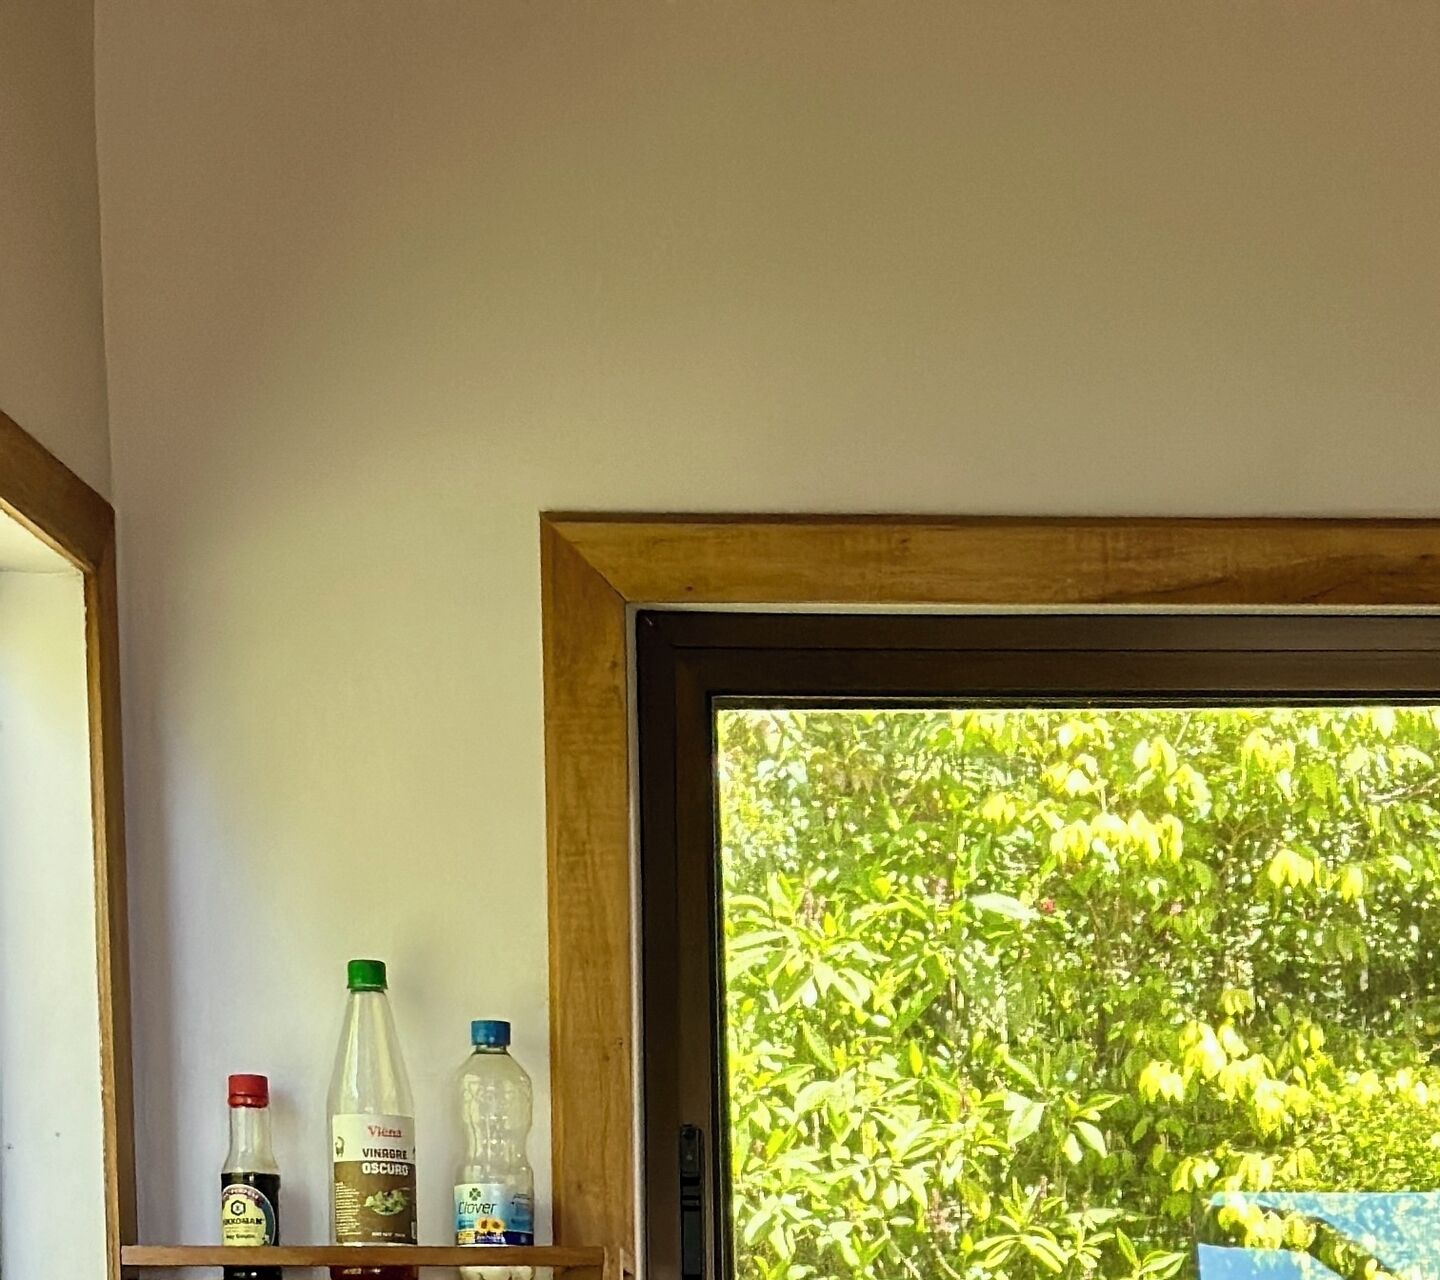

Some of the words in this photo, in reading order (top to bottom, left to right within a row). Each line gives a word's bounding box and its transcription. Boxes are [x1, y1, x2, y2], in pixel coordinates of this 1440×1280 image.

[362, 1148, 408, 1160] VINAGRE
[362, 1162, 409, 1176] OSCURO
[458, 1201, 497, 1215] Clover
